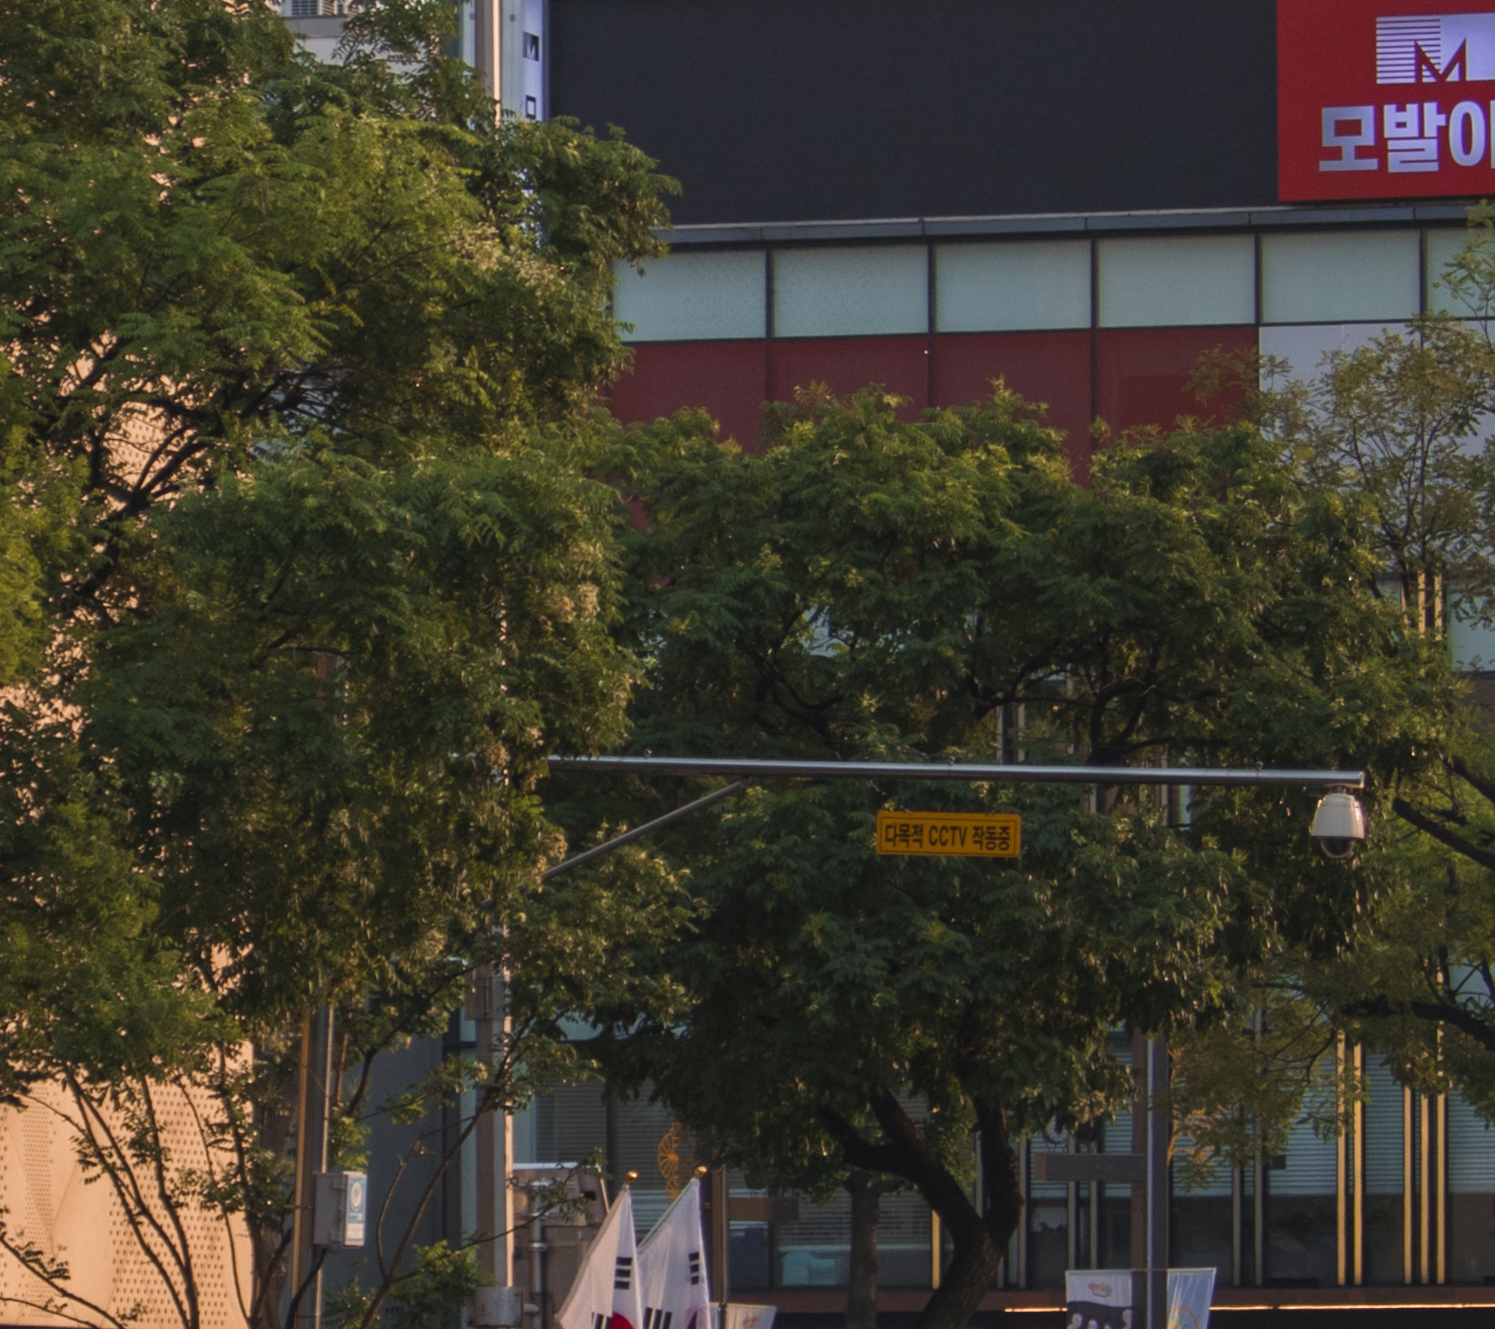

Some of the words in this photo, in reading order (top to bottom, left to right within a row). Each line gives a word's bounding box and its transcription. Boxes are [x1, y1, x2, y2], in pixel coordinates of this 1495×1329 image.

[884, 822, 924, 849] 다목적
[927, 824, 969, 848] CCTV
[971, 825, 1012, 852] 작동중
